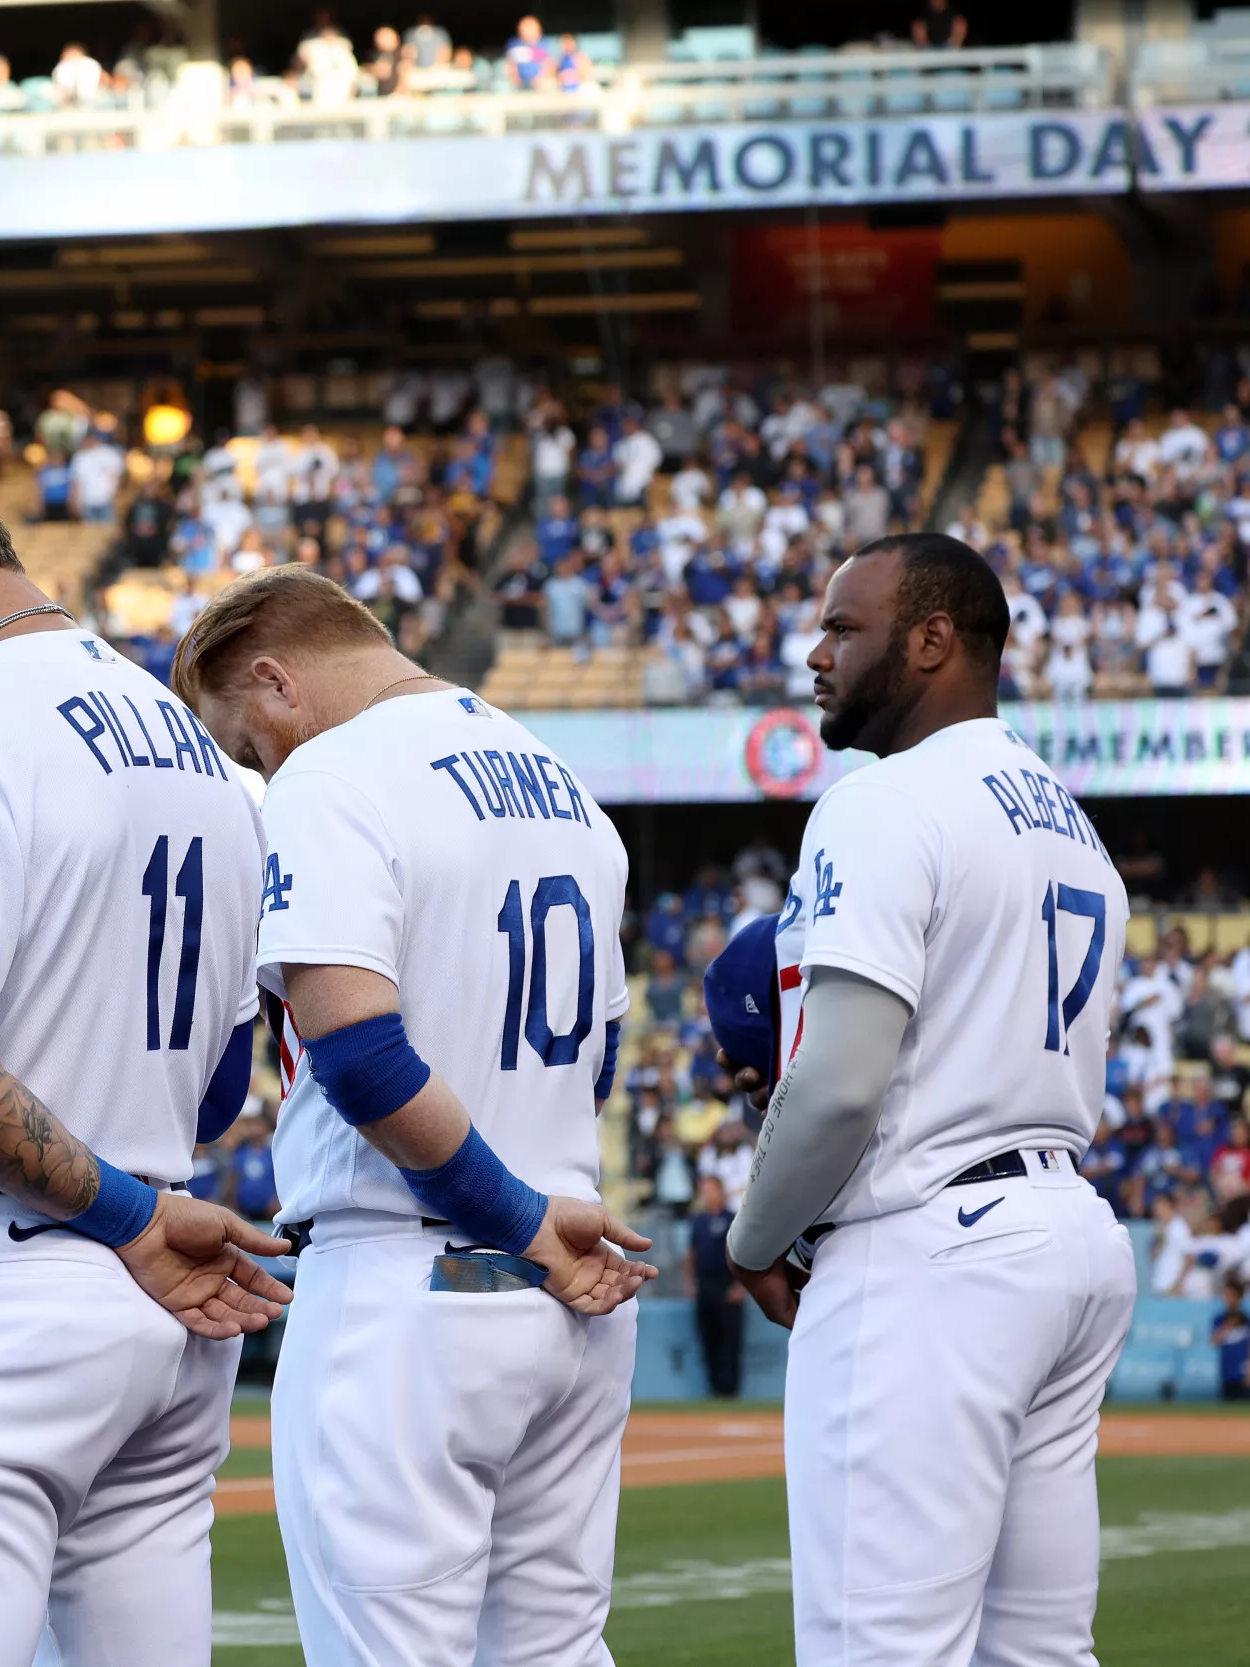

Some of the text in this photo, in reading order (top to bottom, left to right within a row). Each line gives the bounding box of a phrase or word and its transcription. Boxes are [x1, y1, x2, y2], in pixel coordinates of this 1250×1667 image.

[526, 114, 1215, 200] MEMORIAL DAY
[56, 691, 228, 781] PILLAR
[429, 749, 592, 829] TURNER
[141, 834, 204, 1052] 11
[497, 874, 595, 1071] 10
[1041, 879, 1107, 1057] 17
[770, 1072, 794, 1119] HOME
